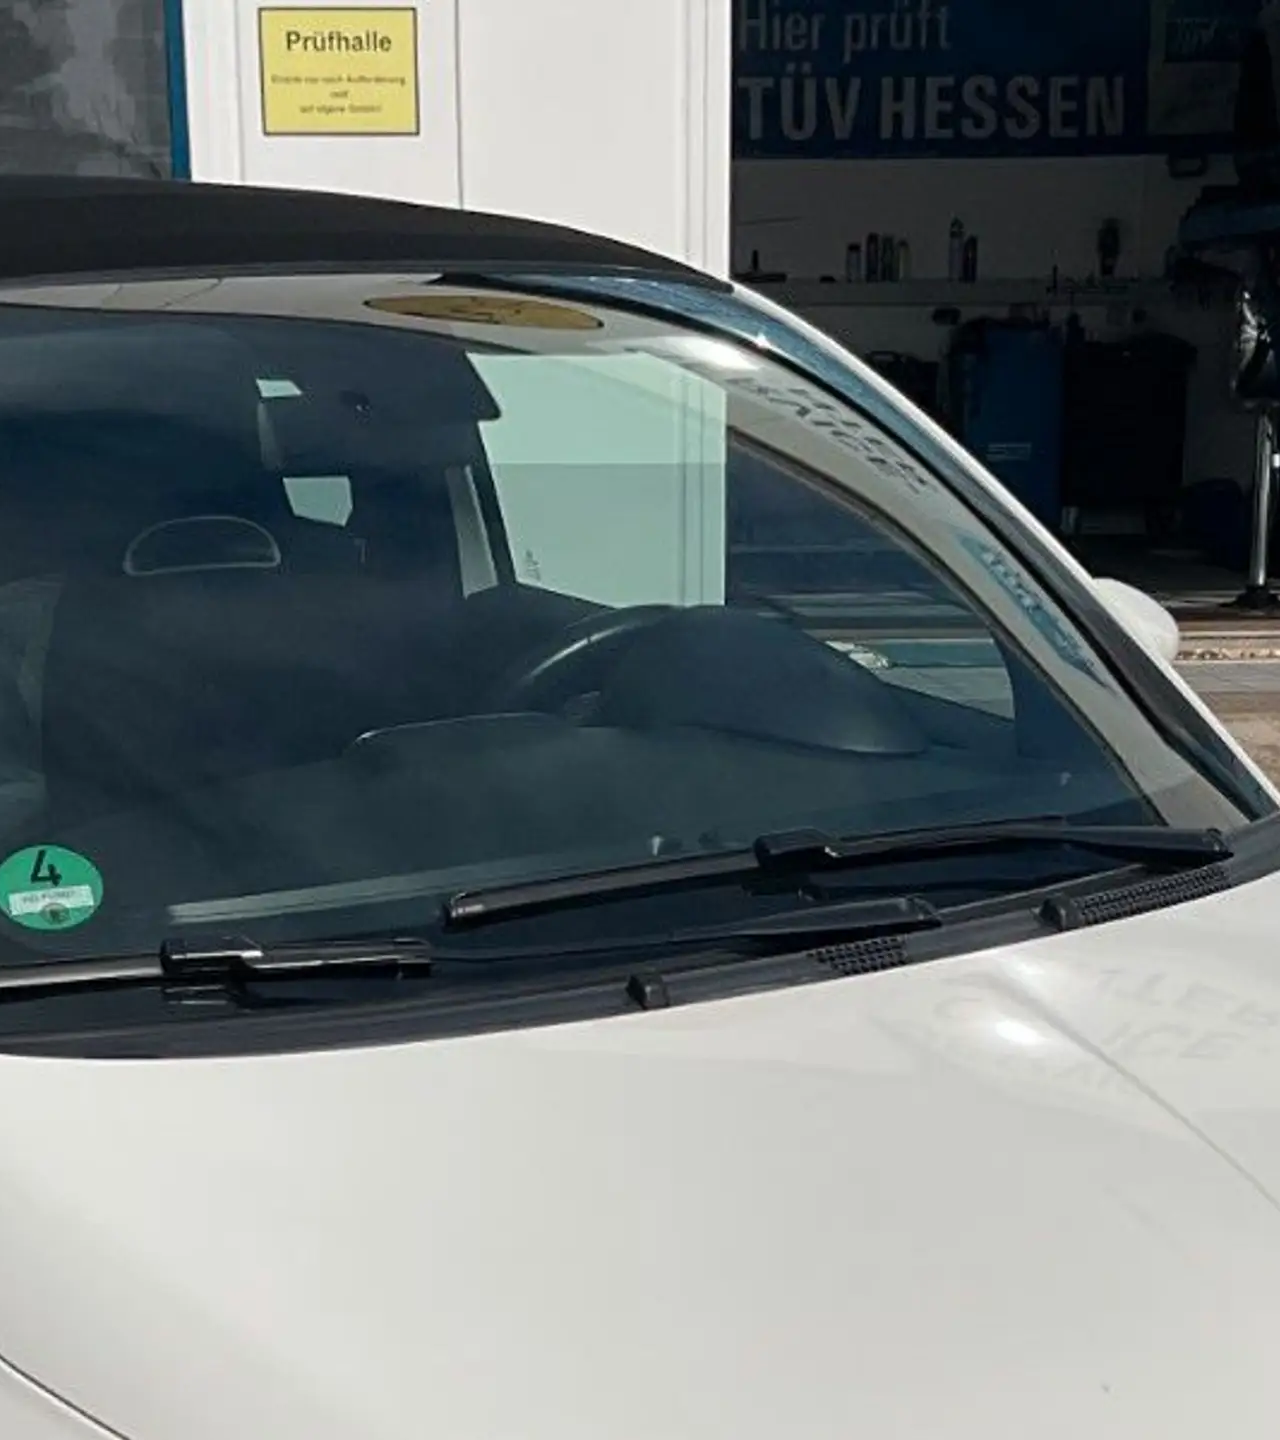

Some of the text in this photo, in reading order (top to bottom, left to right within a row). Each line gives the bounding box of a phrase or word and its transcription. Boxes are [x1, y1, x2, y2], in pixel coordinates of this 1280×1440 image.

[284, 30, 393, 53] Prüfhalle
[738, 0, 952, 64] Hier prüft
[736, 62, 1125, 141] TÜV HESSEN
[30, 849, 62, 886] 4
